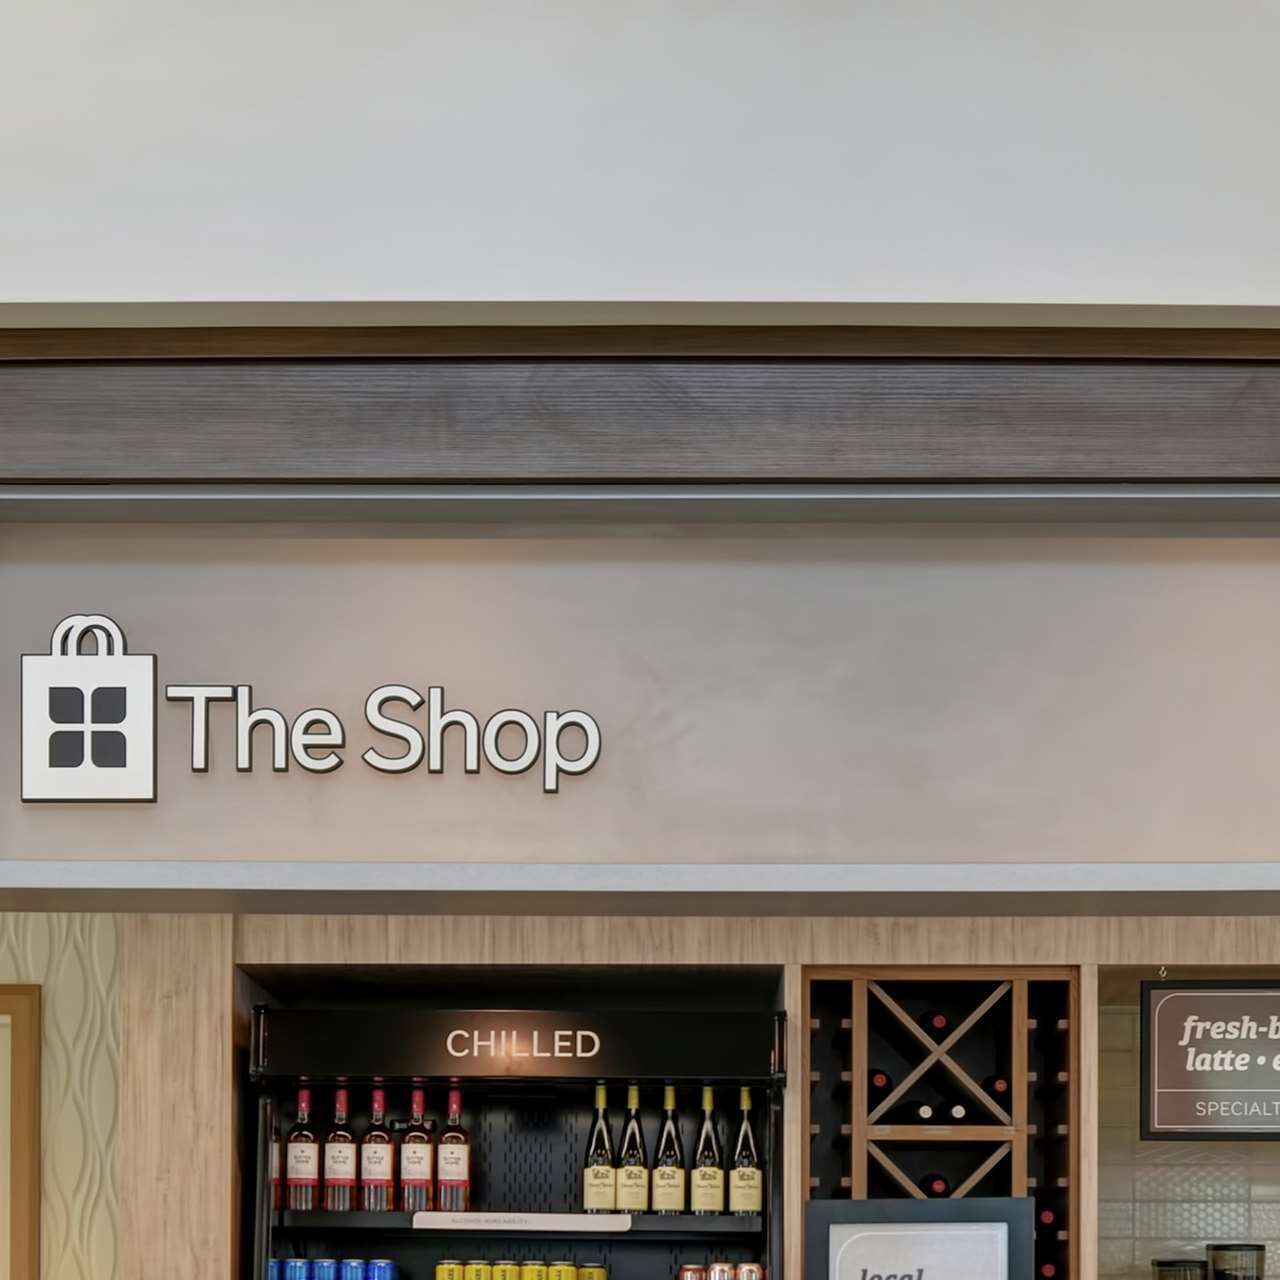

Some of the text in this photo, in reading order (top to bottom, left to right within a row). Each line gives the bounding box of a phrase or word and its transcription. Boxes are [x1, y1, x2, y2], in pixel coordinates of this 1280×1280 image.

[166, 683, 601, 793] The Shop
[446, 1029, 601, 1058] CHILLED
[1185, 1048, 1250, 1072] latte
